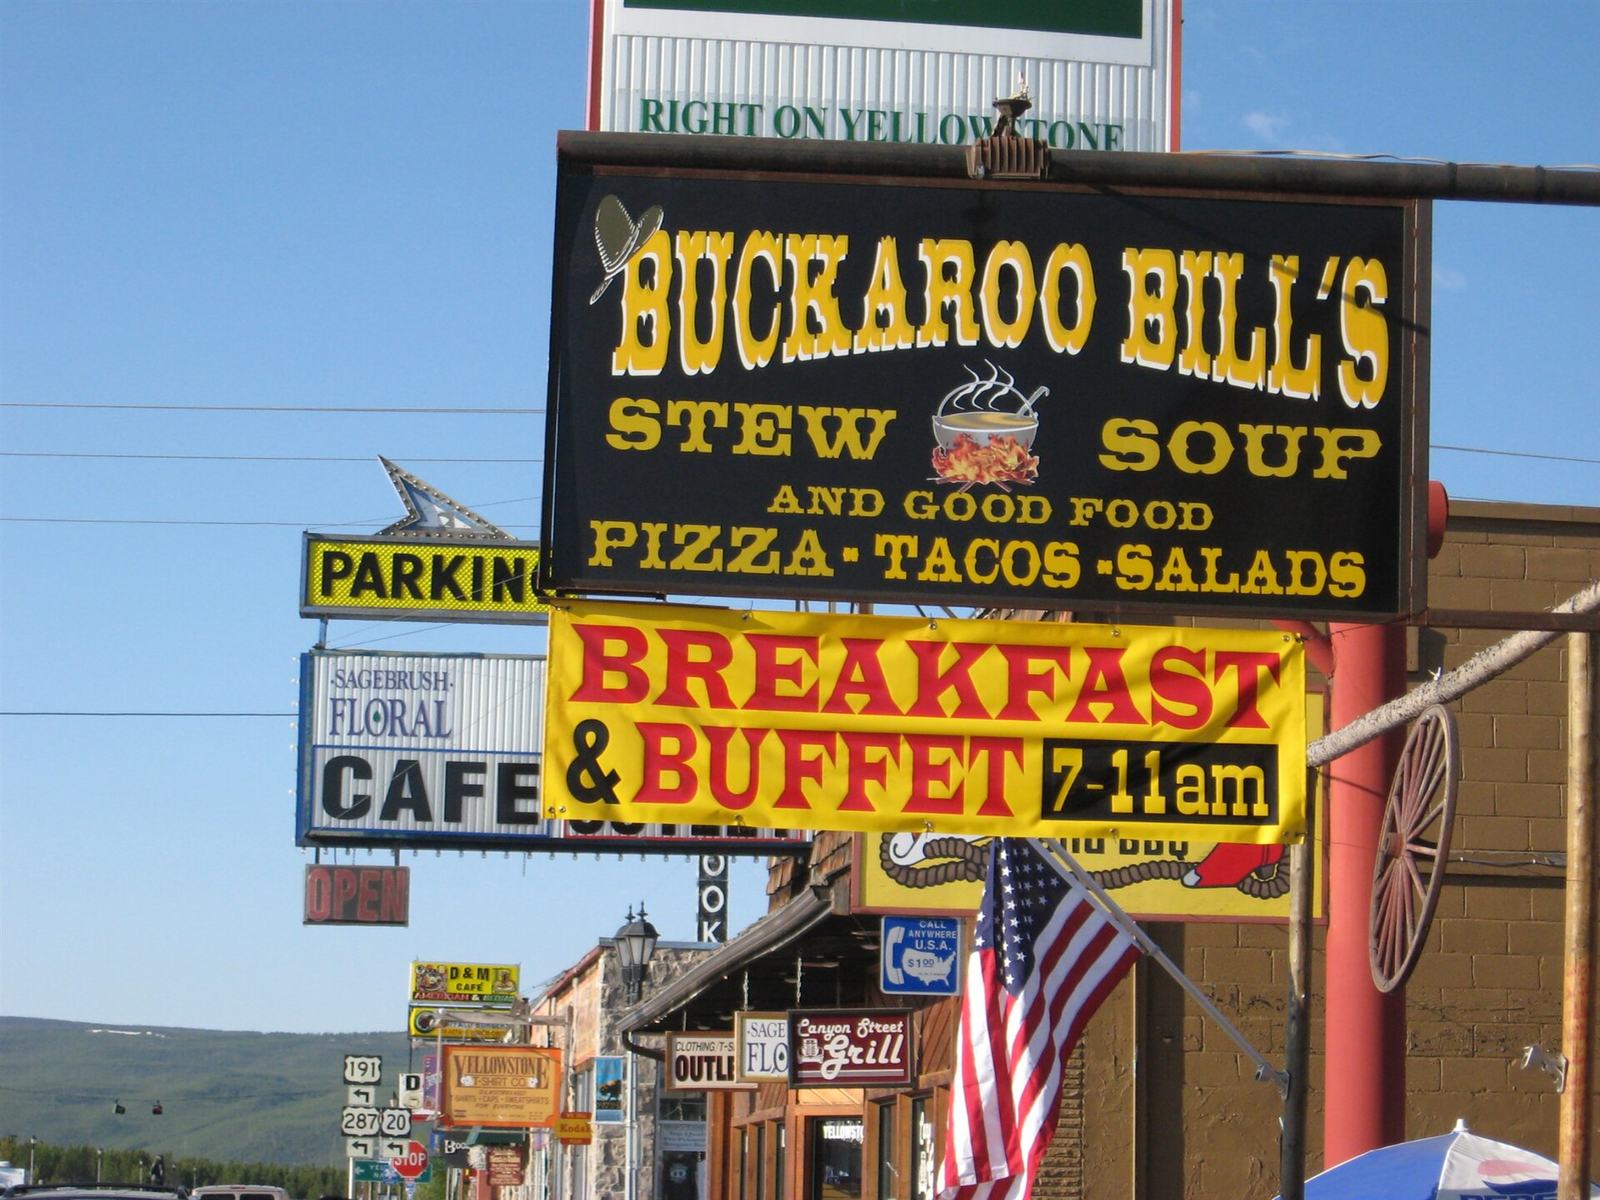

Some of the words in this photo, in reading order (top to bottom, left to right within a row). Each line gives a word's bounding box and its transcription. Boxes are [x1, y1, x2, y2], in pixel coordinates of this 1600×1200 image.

[640, 98, 763, 136] RIGHT
[773, 104, 828, 139] ON
[839, 107, 1124, 151] YELLOWTONE
[611, 229, 1098, 377] BUCKAROO
[1119, 246, 1390, 410] BILL'S
[605, 397, 897, 461] STEW
[1098, 417, 1383, 481] SOUP
[766, 484, 886, 518] AND
[903, 490, 1054, 525] GOOD
[1069, 497, 1214, 532] FOOD
[587, 519, 835, 578] PIZZA
[874, 533, 1082, 590] TACOS
[334, 668, 449, 692] SAGEBRUSH
[568, 622, 1281, 731] BREAKFAST
[328, 697, 452, 739] FLORAL
[566, 718, 622, 805] &
[632, 721, 1025, 818] BUFFET
[1052, 746, 1270, 817] 7-11am
[321, 754, 540, 826] CAFE
[307, 866, 407, 922] OPEN
[908, 929, 958, 939] ANYWHERE
[919, 920, 947, 929] CALL
[914, 939, 952, 951] U.S.A.
[450, 967, 459, 980] D
[463, 967, 473, 979] &
[477, 968, 490, 981] M
[750, 1022, 786, 1038] SAGE
[797, 1018, 852, 1041] Canyon
[856, 1017, 904, 1038] Street
[675, 1041, 716, 1052] CLOTHING
[746, 1042, 789, 1073] FLO
[820, 1034, 905, 1081] Grill
[350, 1061, 376, 1077] 191
[453, 1055, 551, 1089] YELLOWSTONE
[344, 1113, 377, 1130] 287
[387, 1114, 406, 1130] 20
[560, 1122, 592, 1133] Kodak
